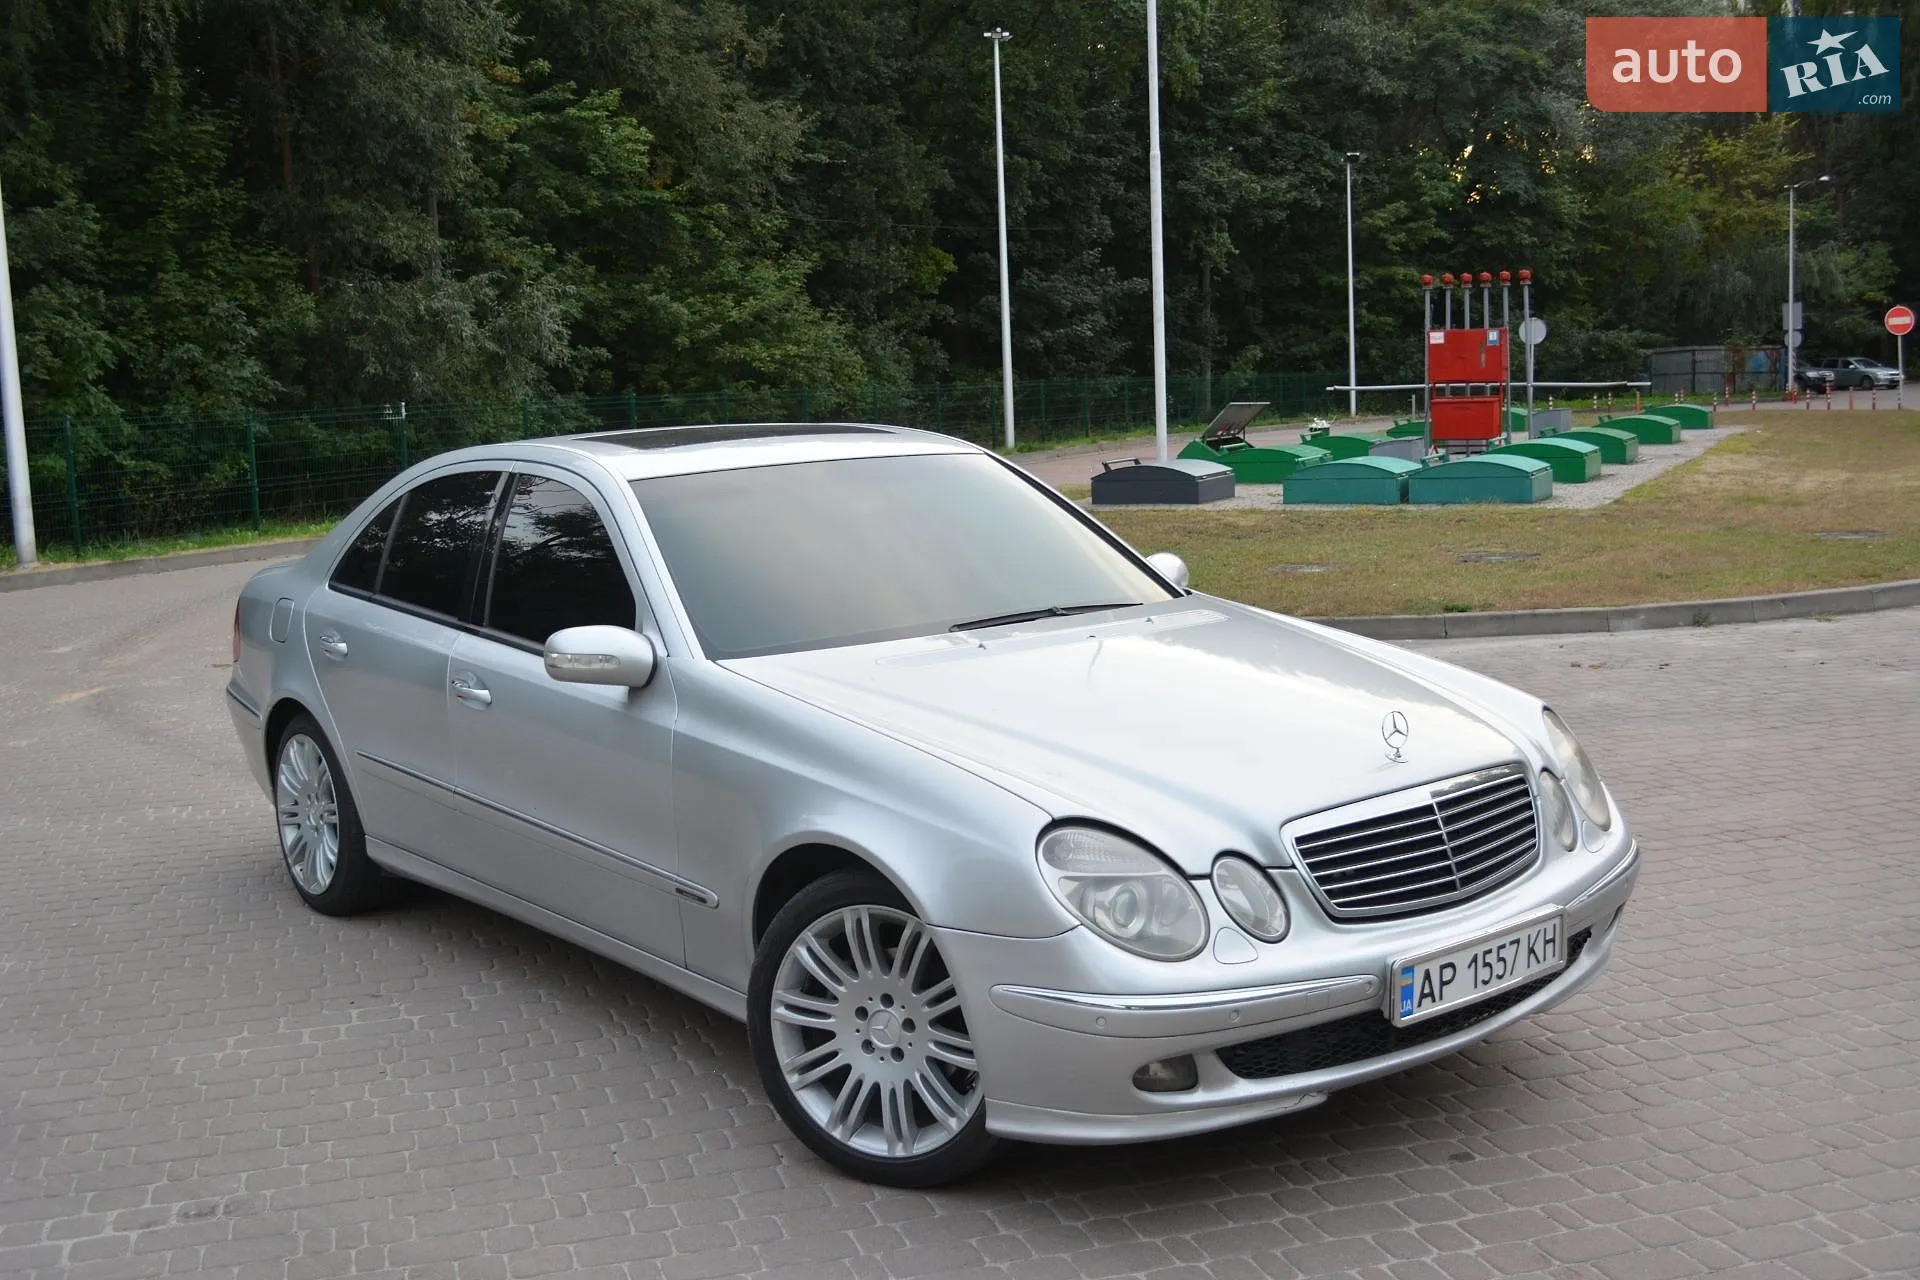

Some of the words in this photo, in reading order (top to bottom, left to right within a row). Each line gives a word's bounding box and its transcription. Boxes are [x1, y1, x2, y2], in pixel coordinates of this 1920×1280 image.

[1417, 961, 1457, 1008] AP
[1467, 938, 1521, 989] 1557
[1527, 923, 1557, 968] KH
